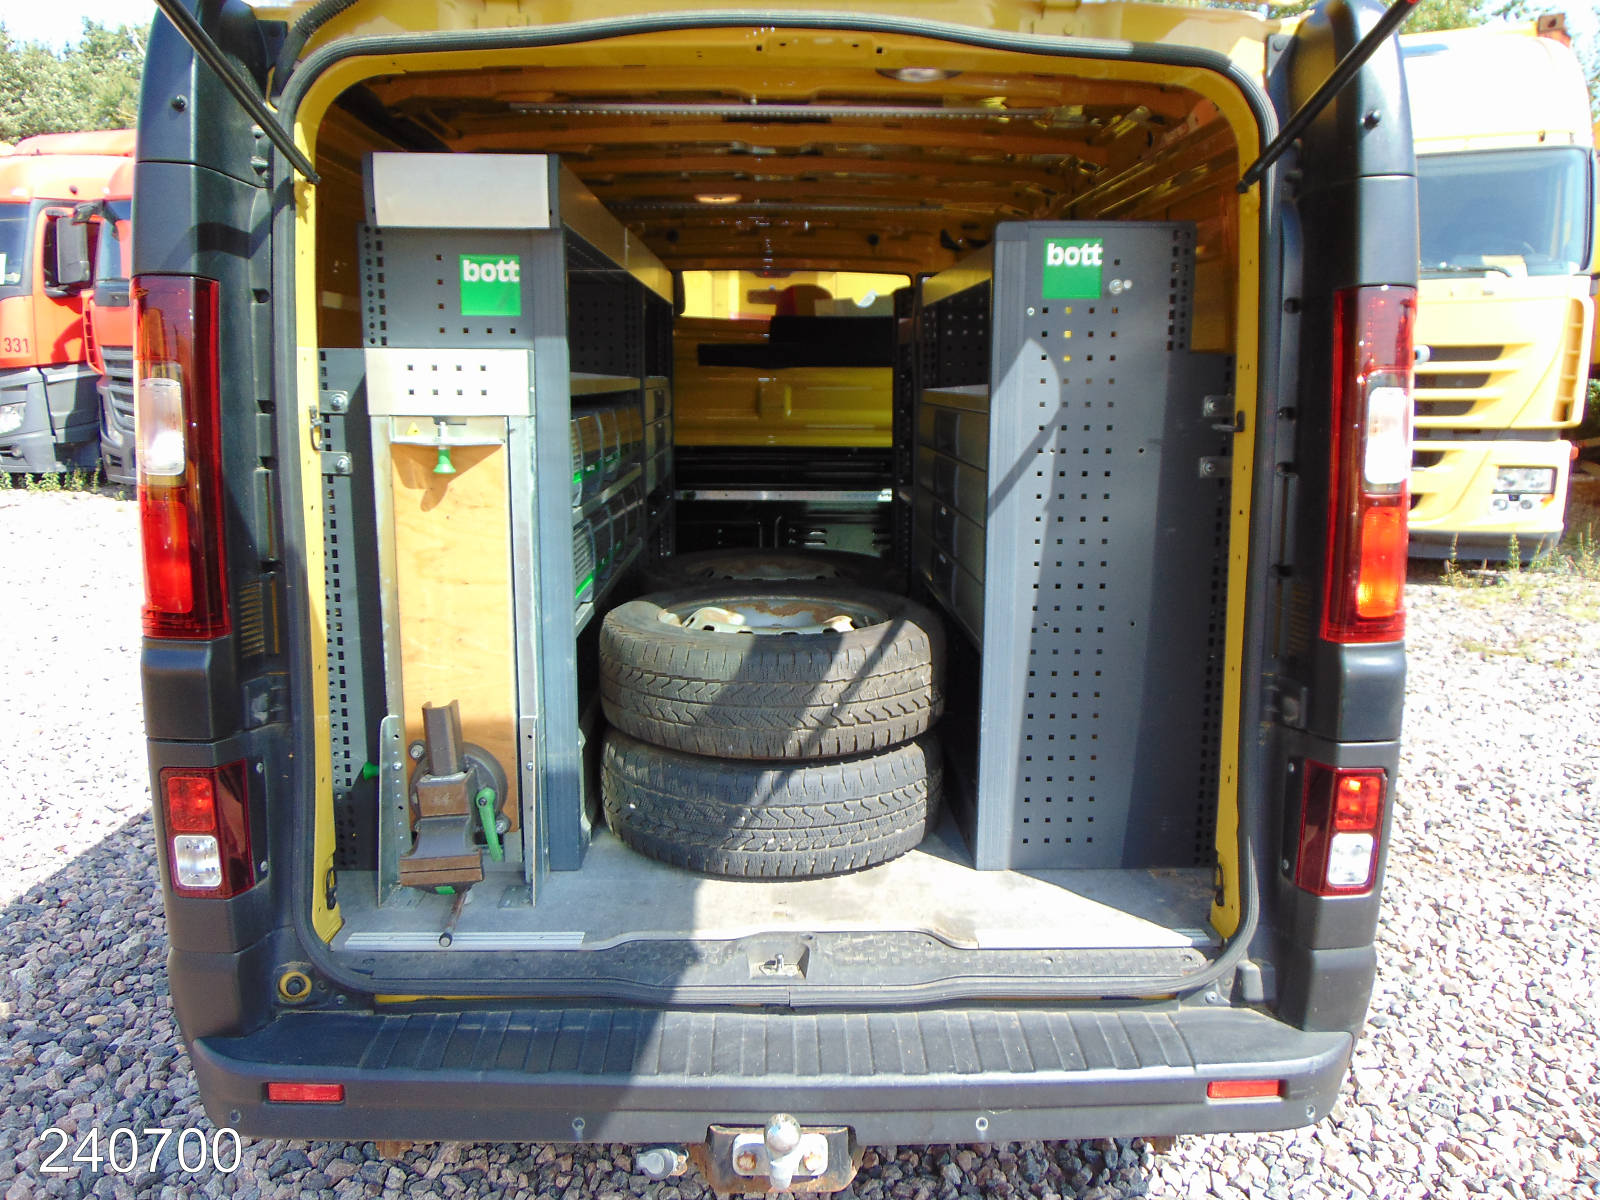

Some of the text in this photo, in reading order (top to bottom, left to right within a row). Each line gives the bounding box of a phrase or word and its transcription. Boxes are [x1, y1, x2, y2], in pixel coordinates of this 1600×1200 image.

[1047, 243, 1103, 267] bott
[463, 259, 520, 282] bott
[4, 337, 29, 353] 331
